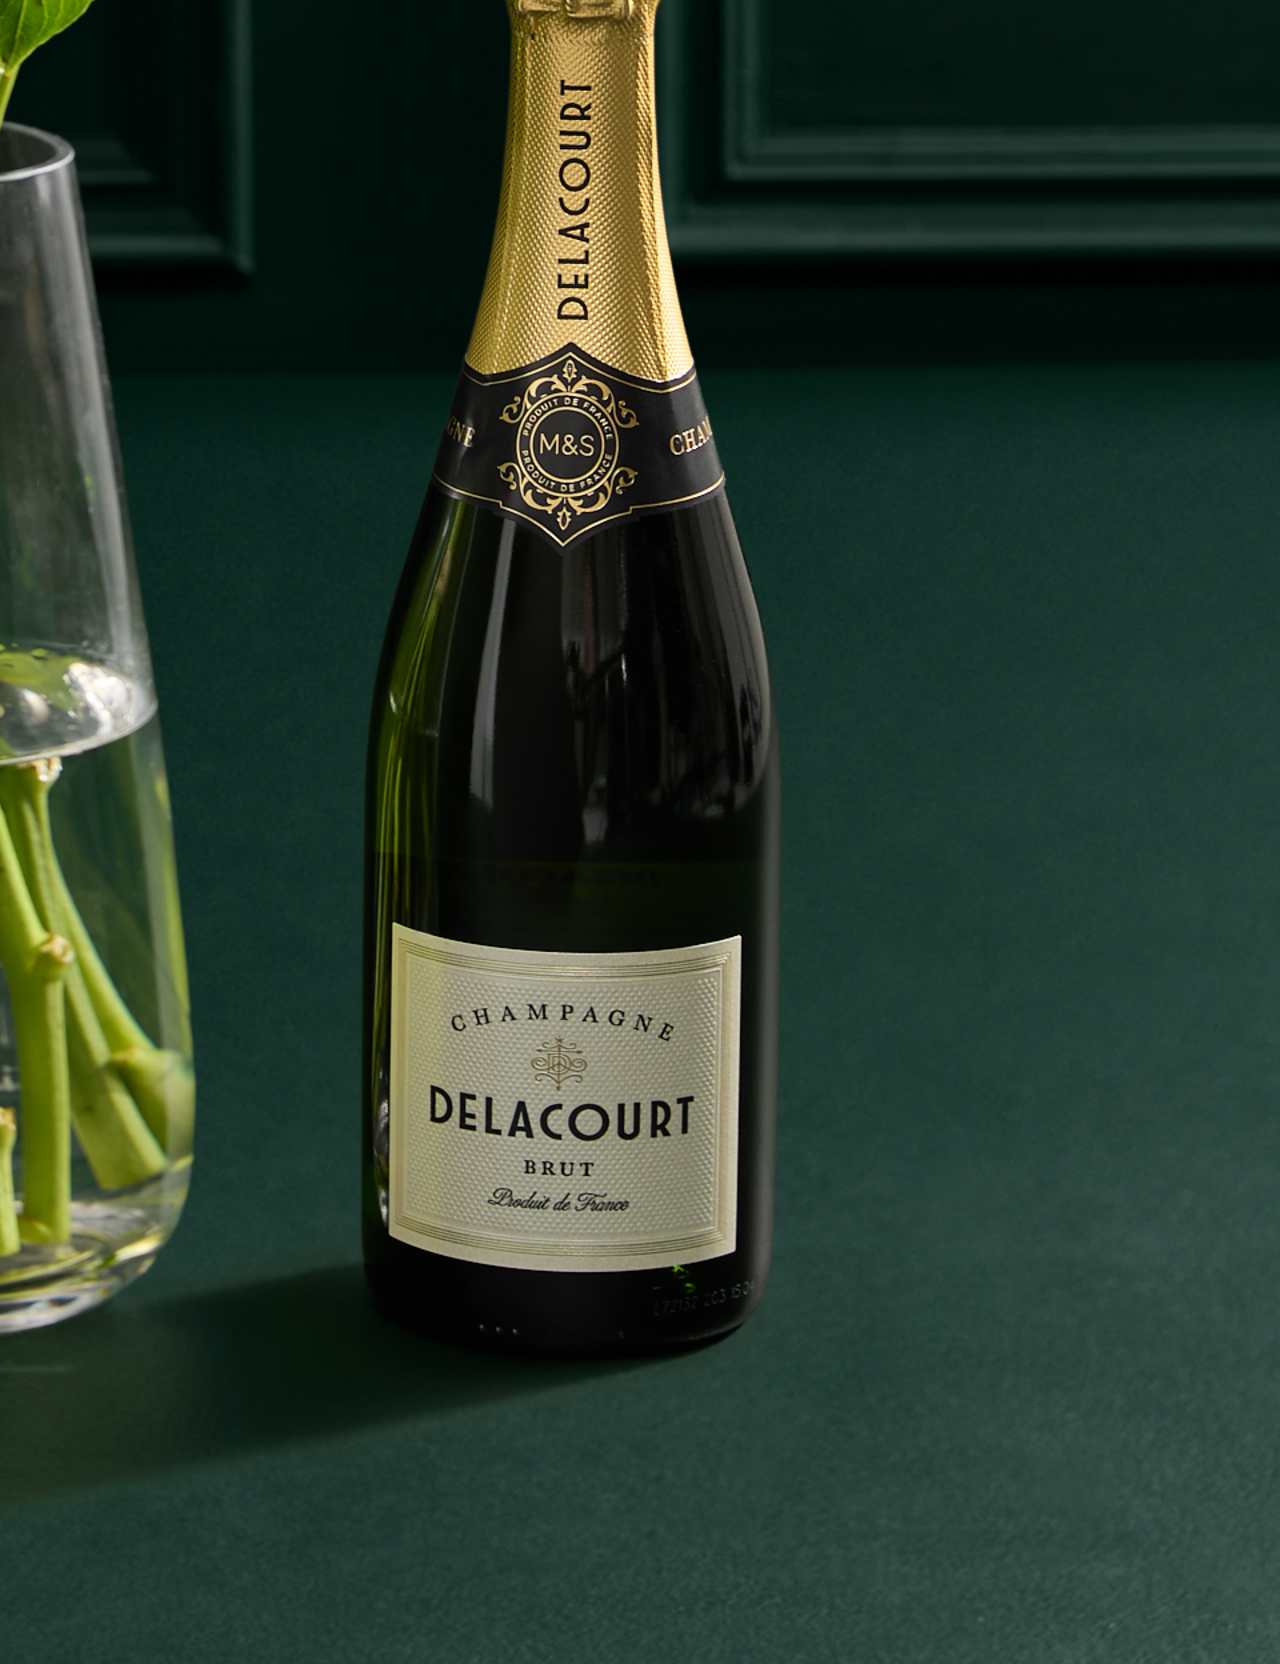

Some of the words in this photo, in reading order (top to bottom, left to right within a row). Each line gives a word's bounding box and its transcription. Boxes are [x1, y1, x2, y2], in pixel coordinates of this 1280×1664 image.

[557, 79, 593, 321] DELACOURT
[522, 398, 558, 438] PRODUIT
[563, 396, 578, 406] DE
[582, 399, 614, 440] FRANCE
[539, 432, 595, 457] M&S
[521, 449, 556, 489] PRODUIT
[560, 483, 575, 493] DE
[580, 453, 613, 490] FRANCE
[451, 1003, 675, 1042] CHAMPAGNE
[429, 1085, 696, 1142] DELACOURT
[524, 1159, 595, 1177] BRUT
[488, 1187, 550, 1210] Produit
[552, 1192, 571, 1211] de
[575, 1192, 630, 1212] France
